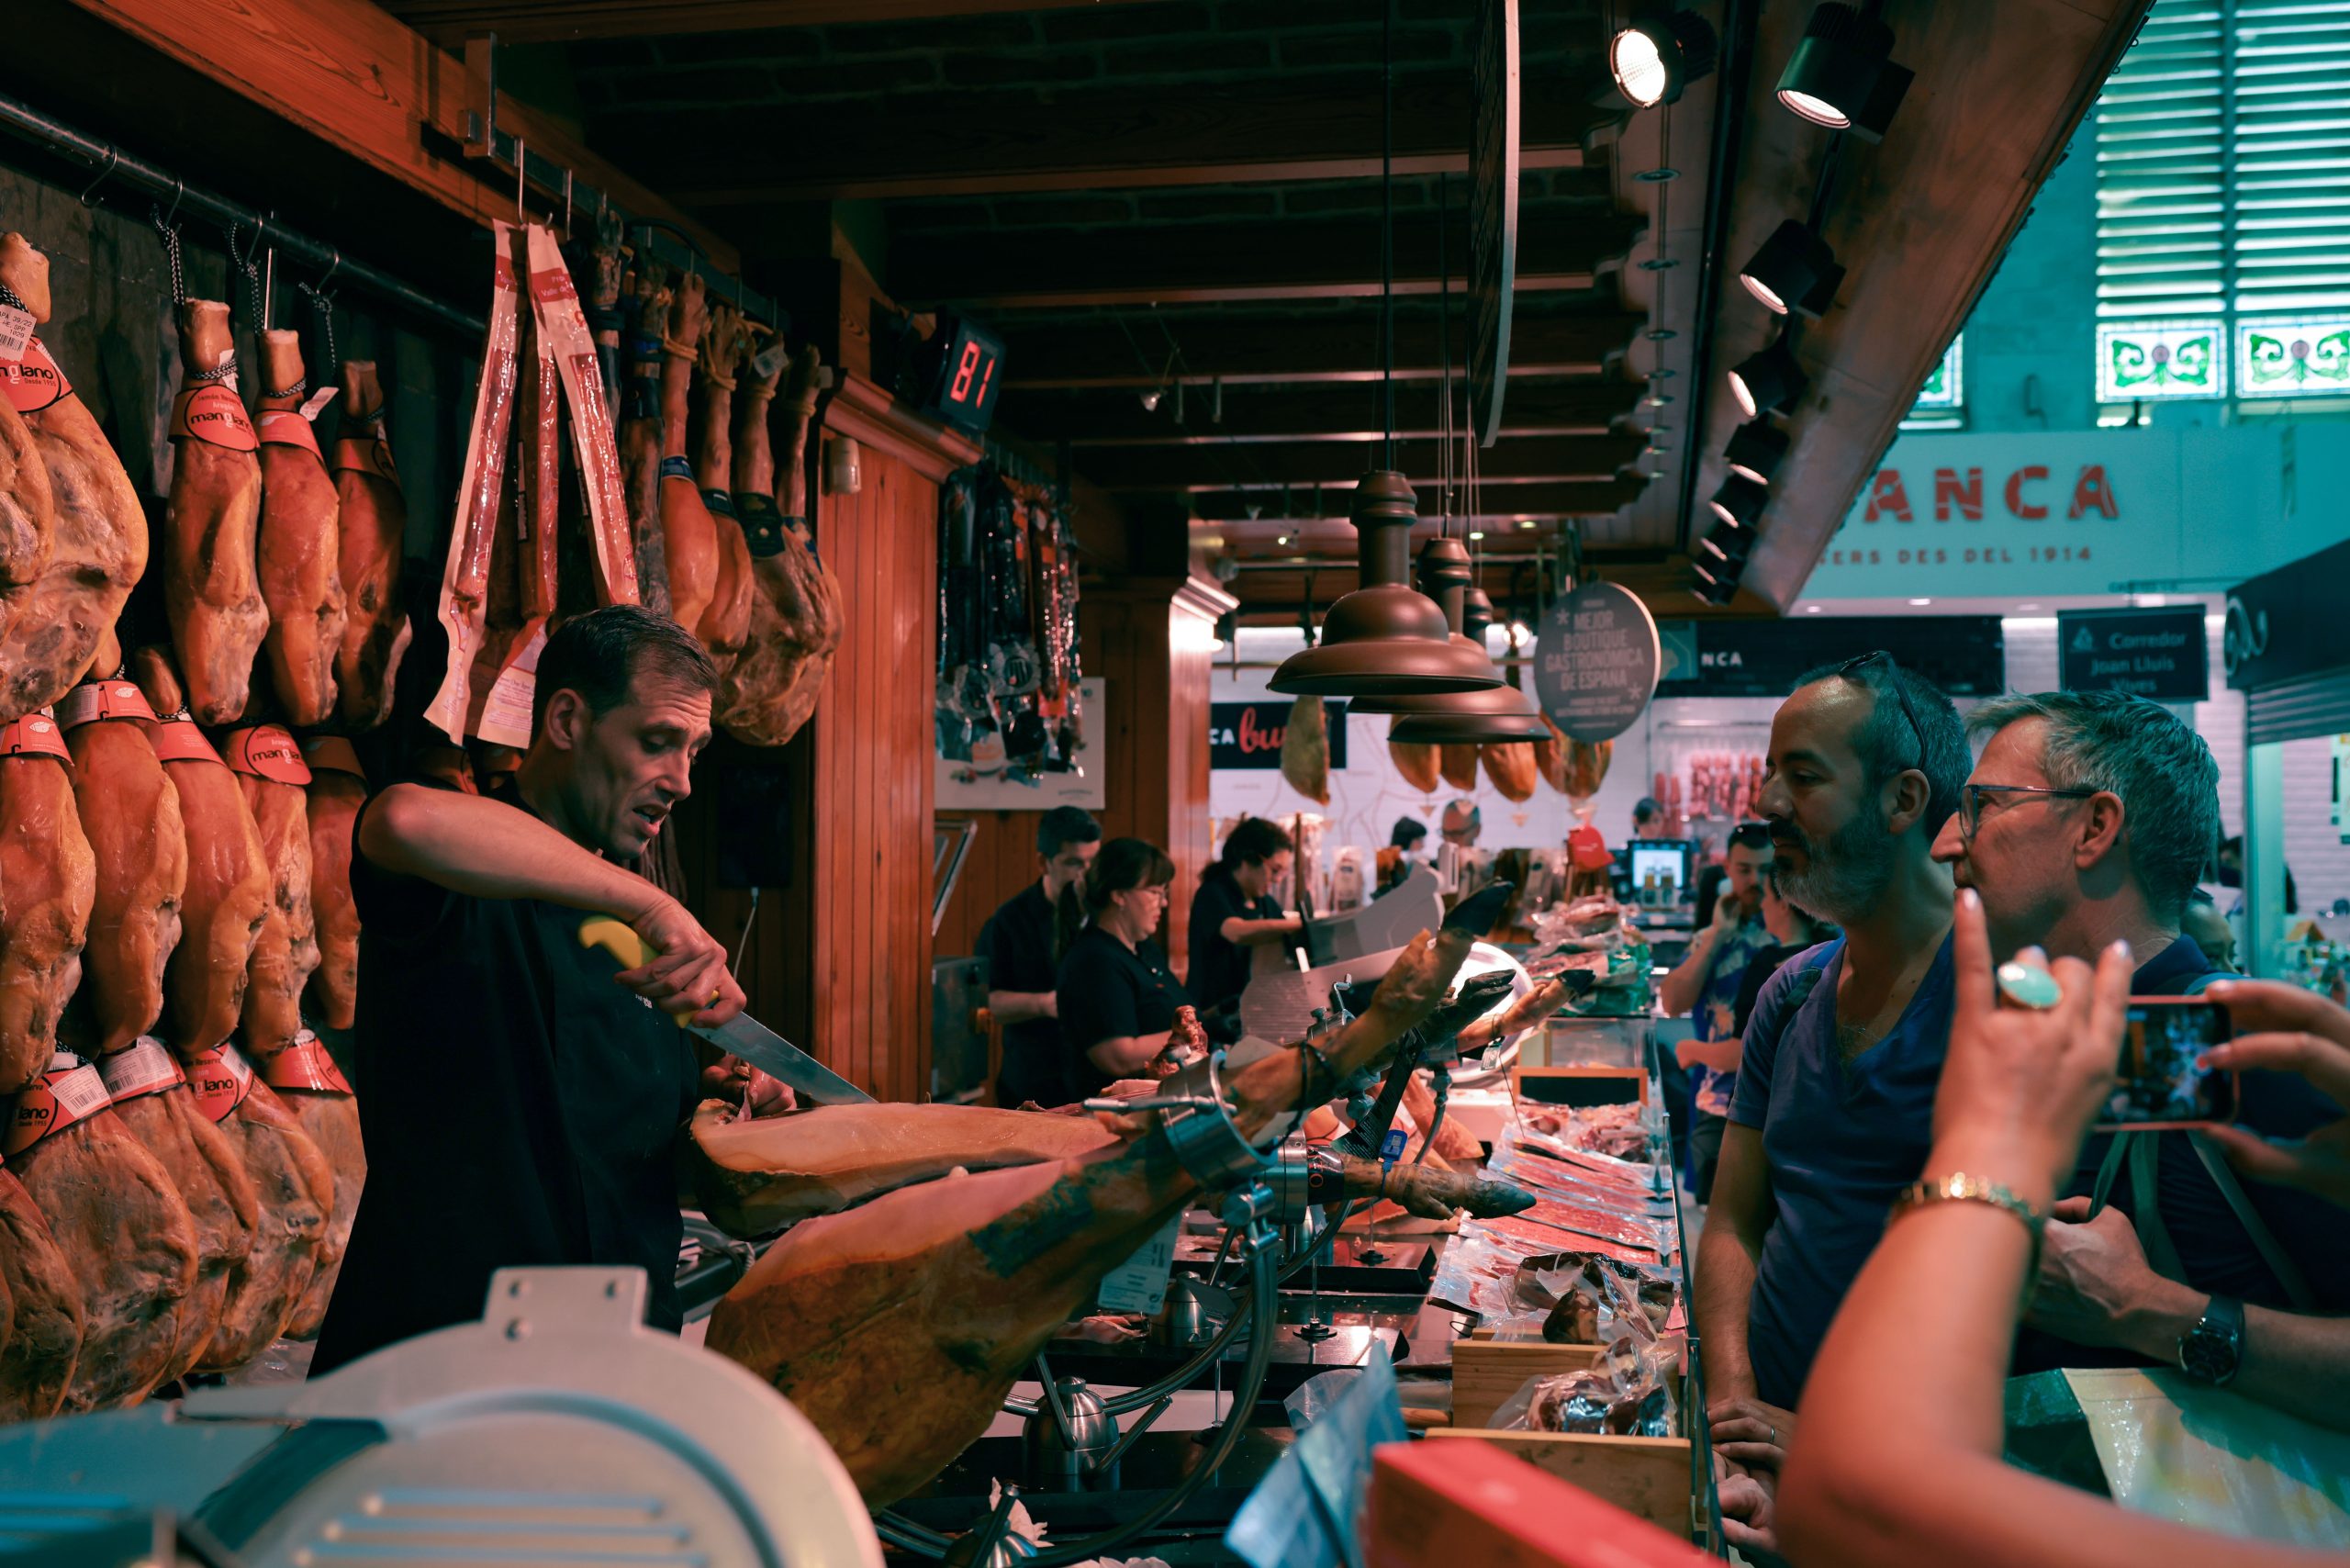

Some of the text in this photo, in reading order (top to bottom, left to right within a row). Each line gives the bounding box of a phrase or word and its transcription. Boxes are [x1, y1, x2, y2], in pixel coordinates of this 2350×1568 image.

[950, 340, 996, 409] 81
[1863, 465, 2120, 522] ANCA
[1897, 548, 1948, 565] DES
[1964, 546, 2013, 564] DEL
[2030, 545, 2092, 563] 1914
[1573, 610, 1615, 631] MEJOR
[1563, 628, 1628, 652] BOUTIQUE
[2109, 632, 2188, 651] Corredor
[1701, 651, 1744, 667] NCA
[2089, 657, 2132, 678] Joan
[1561, 672, 1578, 691] DE
